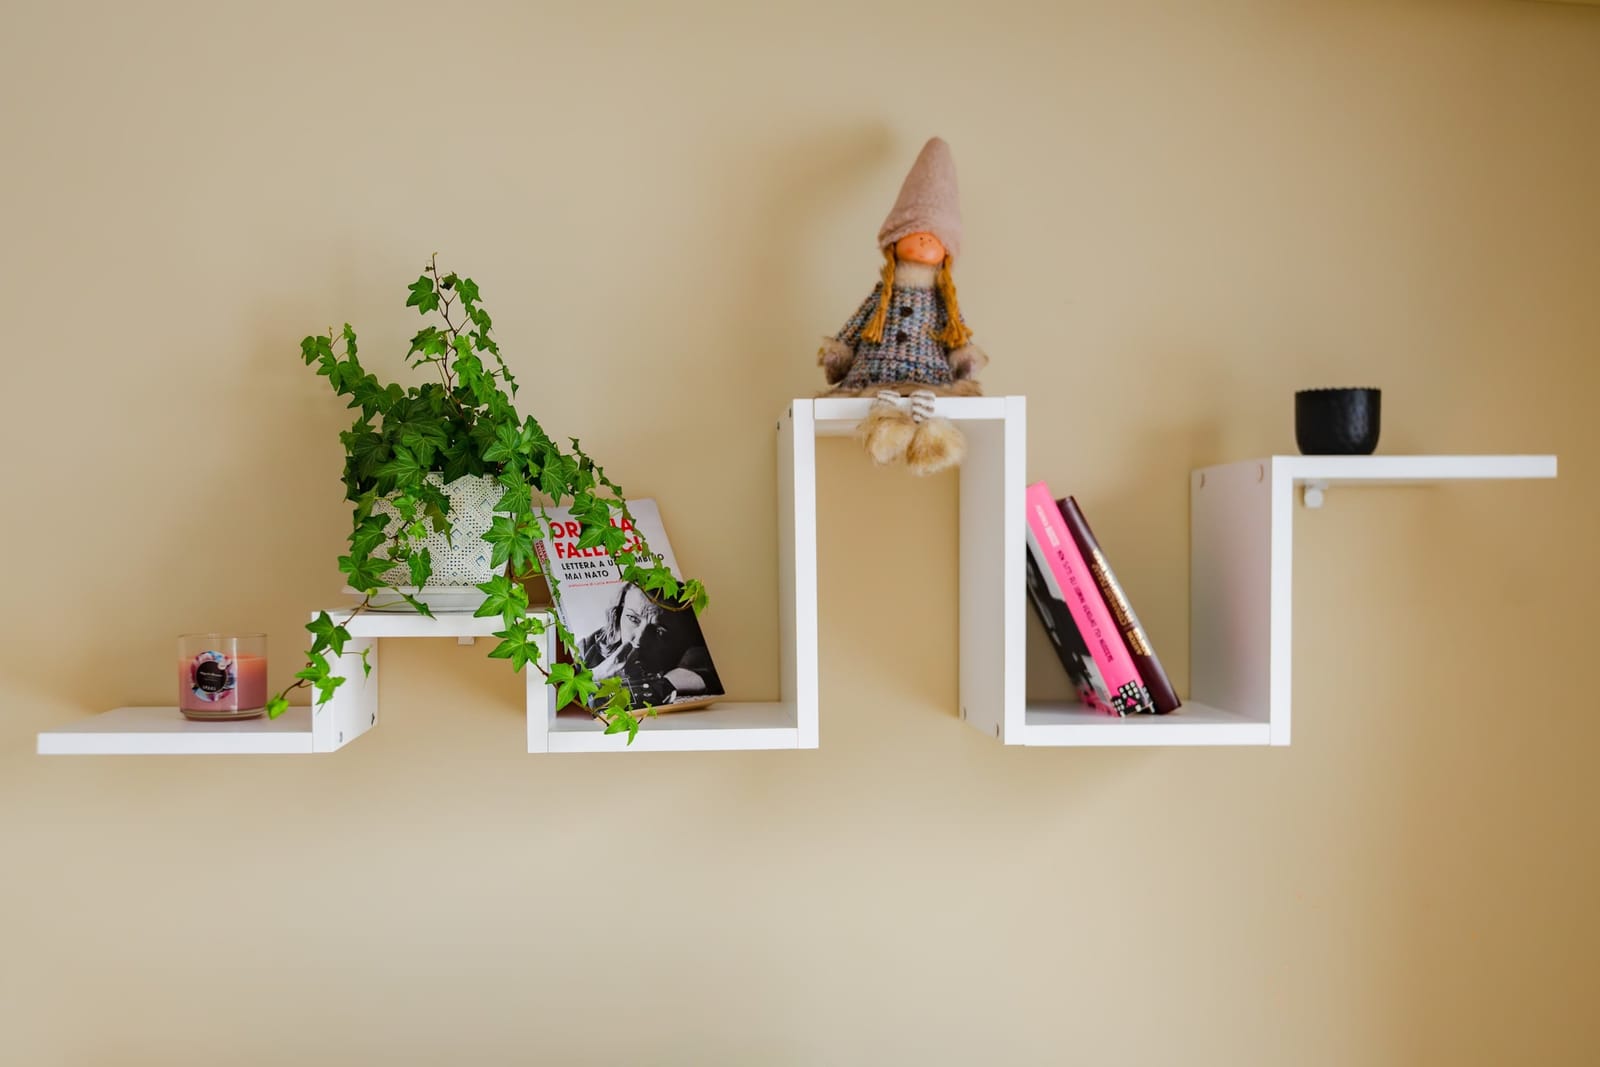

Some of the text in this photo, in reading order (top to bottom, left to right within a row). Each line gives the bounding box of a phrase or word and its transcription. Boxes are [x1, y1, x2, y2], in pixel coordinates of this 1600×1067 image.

[561, 561, 596, 570] LETTERA
[564, 570, 609, 580] MAI NATO
